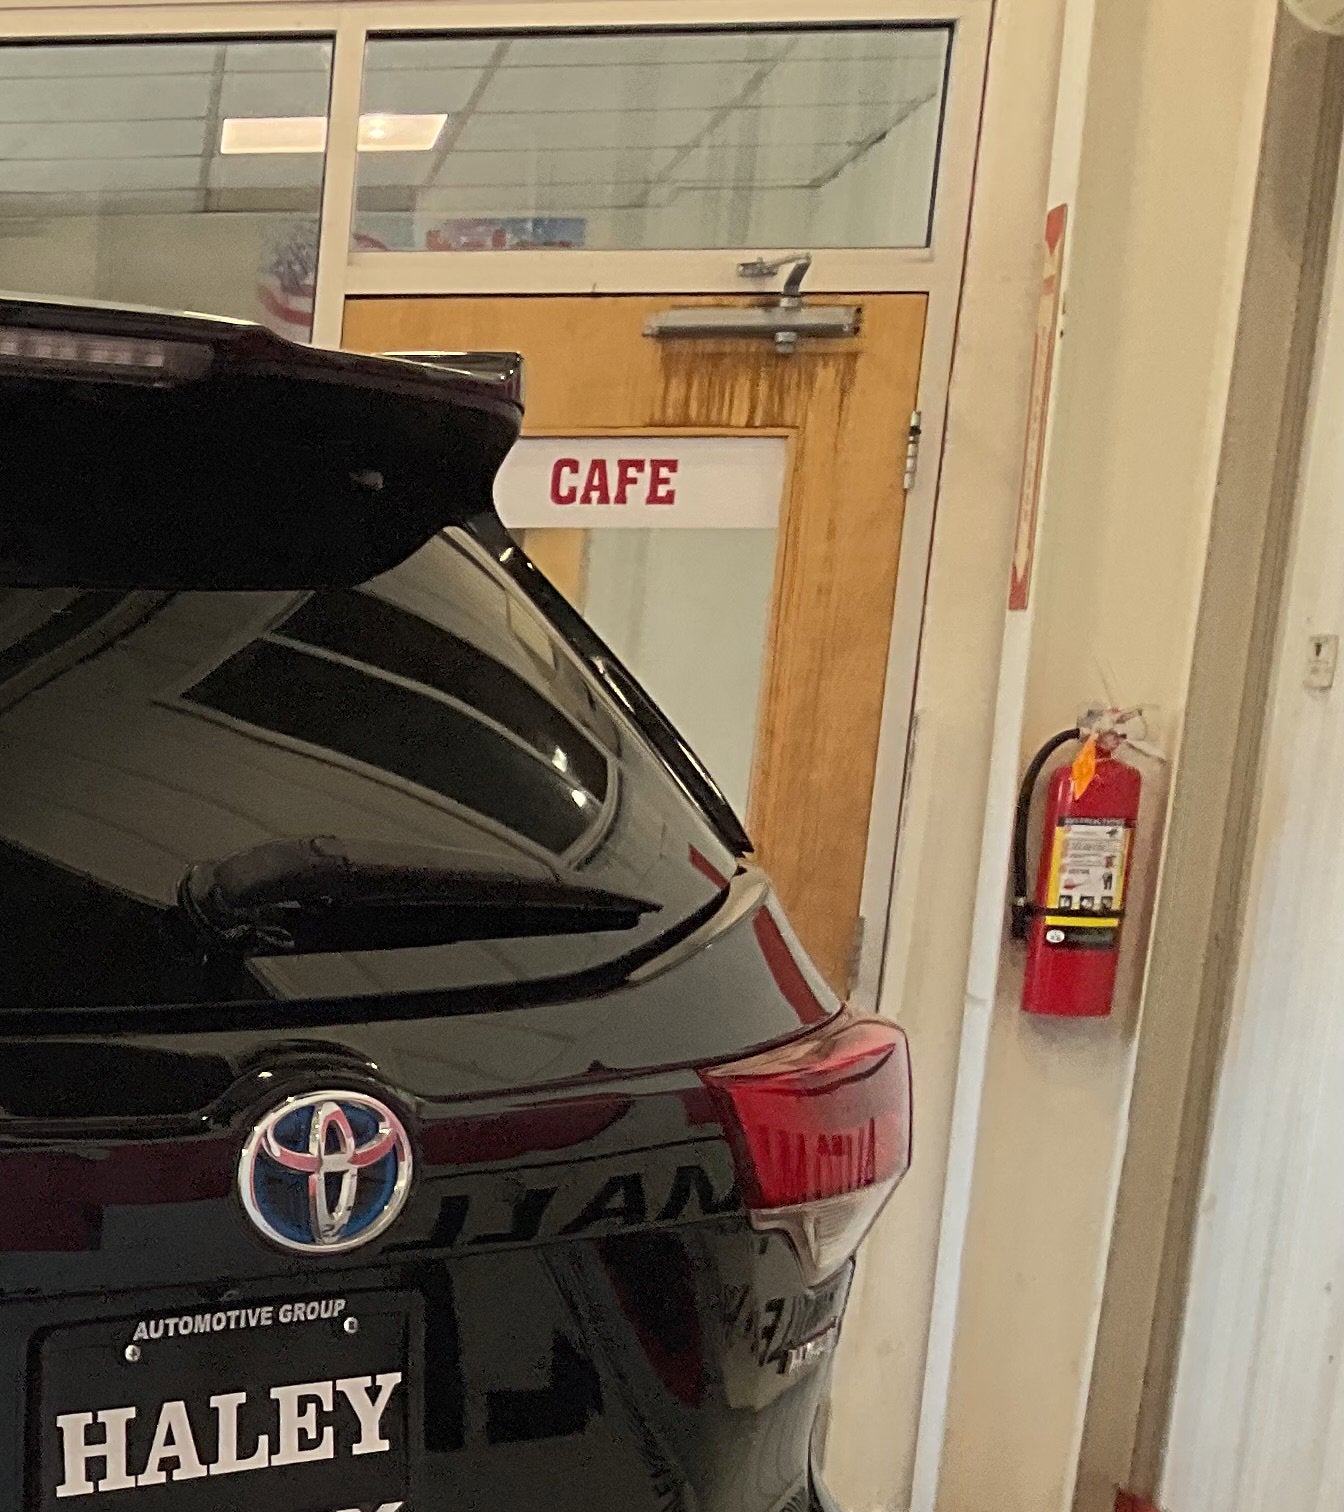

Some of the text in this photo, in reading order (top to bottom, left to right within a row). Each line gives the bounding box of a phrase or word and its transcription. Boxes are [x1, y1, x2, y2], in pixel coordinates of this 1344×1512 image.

[550, 457, 679, 505] CAFE
[132, 1298, 346, 1341] AUTOMOTIVE GROUP
[56, 1371, 402, 1498] HALEY
